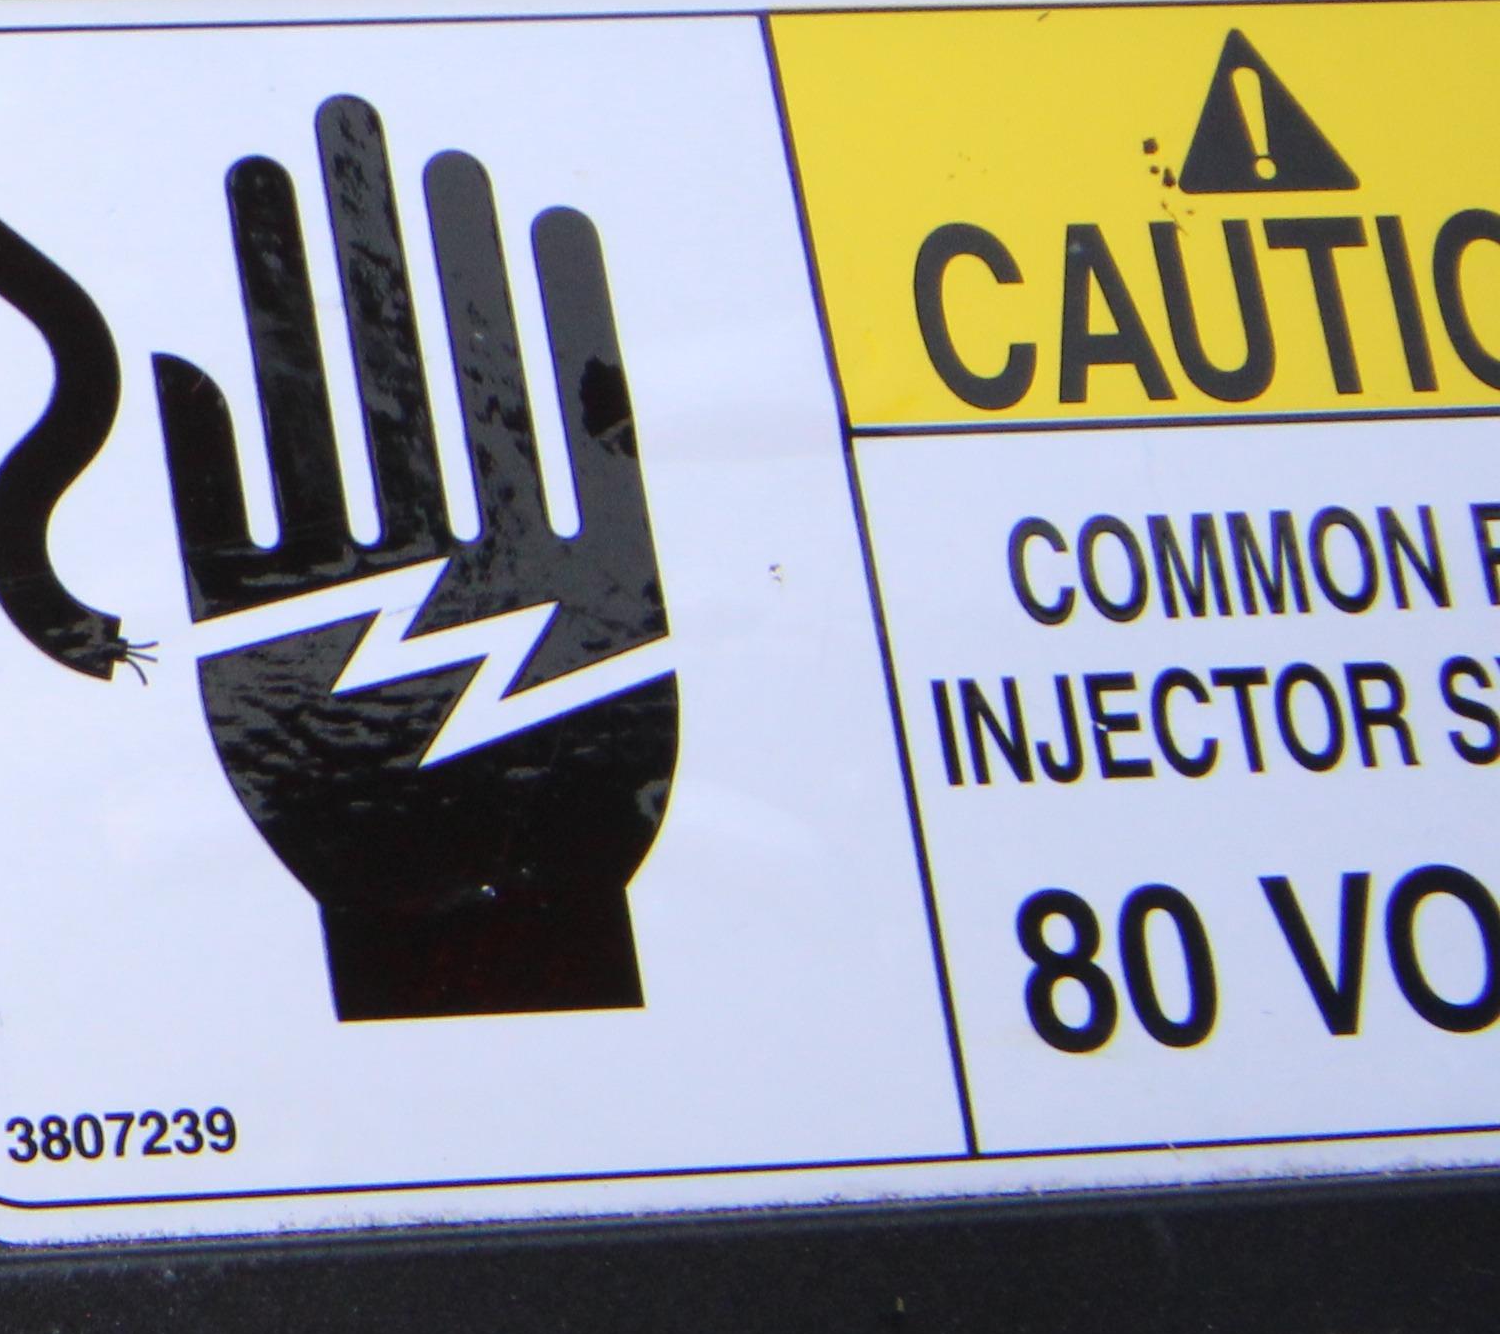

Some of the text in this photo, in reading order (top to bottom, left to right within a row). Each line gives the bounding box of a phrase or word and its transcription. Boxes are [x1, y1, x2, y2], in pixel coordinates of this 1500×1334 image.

[1008, 506, 1450, 625] COMMON
[932, 662, 1419, 785] INJECTOR
[1016, 884, 1217, 1053] 80
[6, 1107, 236, 1162] 3807239
